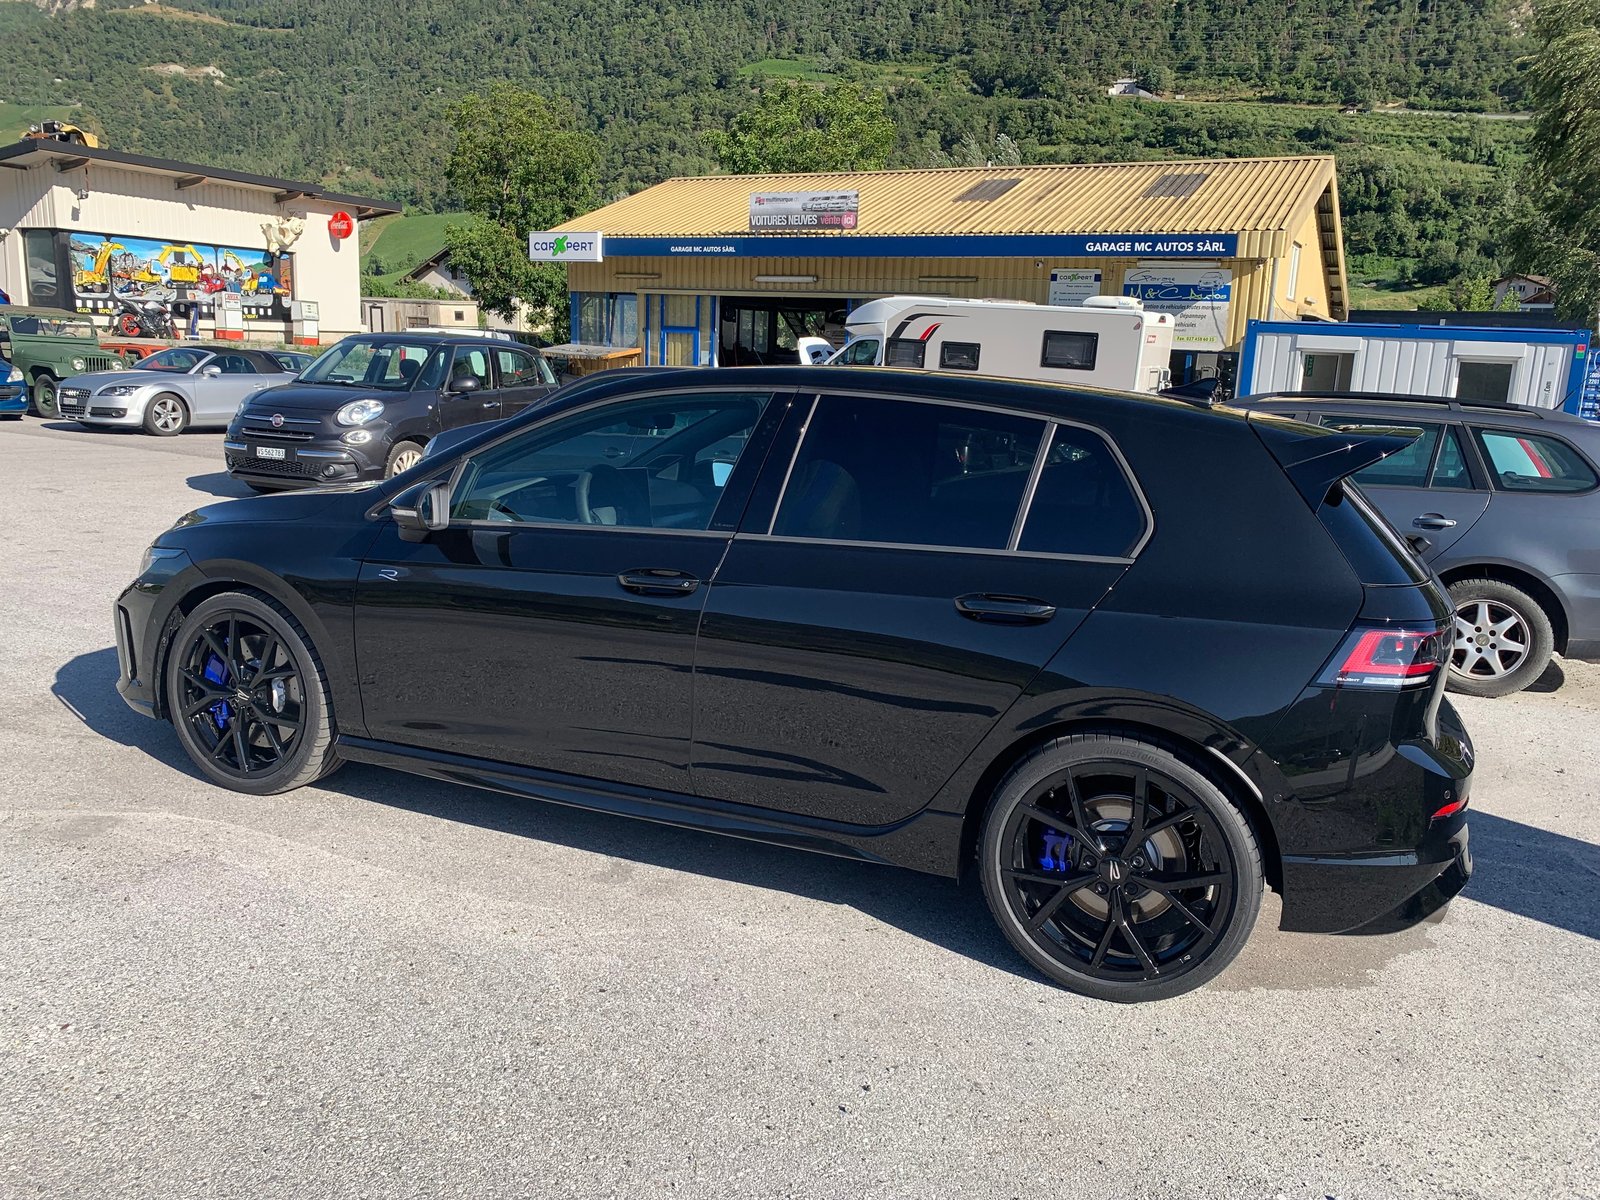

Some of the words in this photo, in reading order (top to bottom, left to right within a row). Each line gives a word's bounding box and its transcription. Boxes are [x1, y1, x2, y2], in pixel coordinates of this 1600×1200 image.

[751, 215, 787, 226] VOITURES
[788, 214, 817, 225] NEUVES
[843, 214, 853, 225] ici
[1085, 242, 1131, 252] GARAGE
[1134, 242, 1152, 252] MC
[1155, 242, 1194, 252] AUTOS
[1129, 270, 1175, 286] Garage
